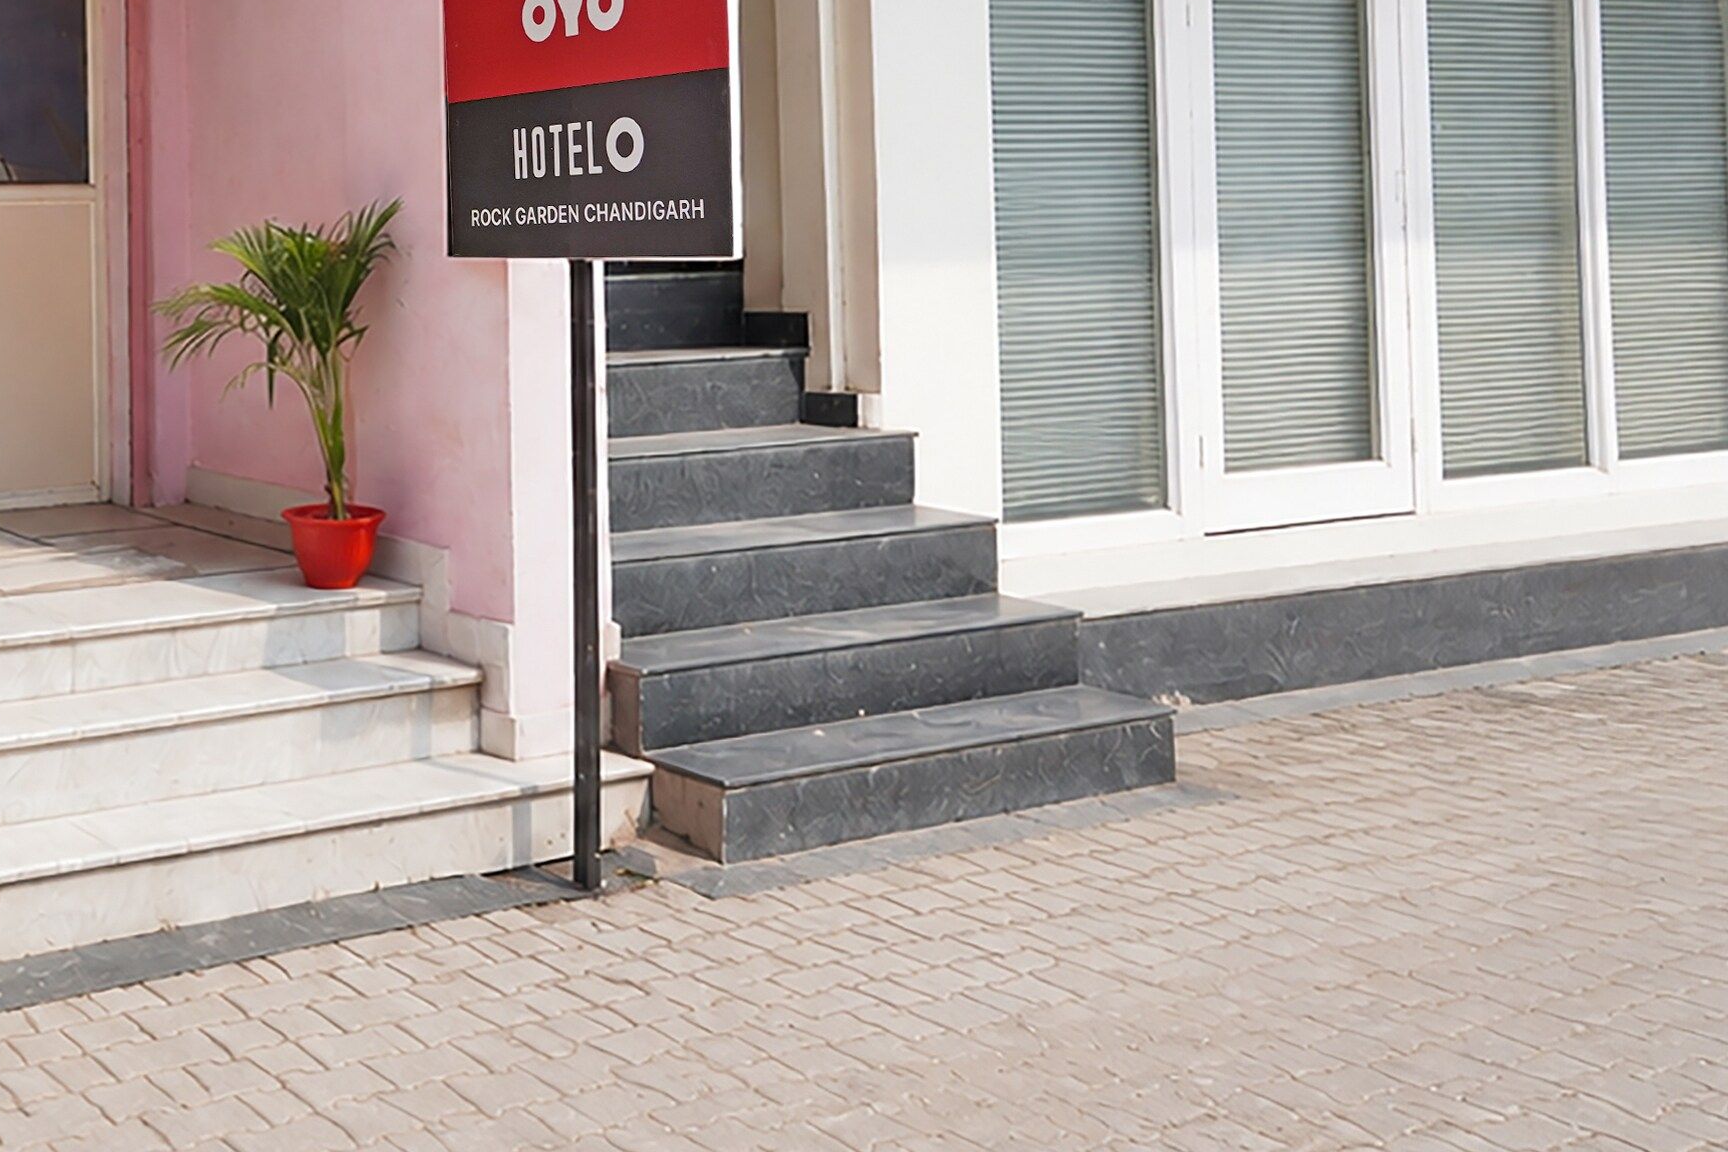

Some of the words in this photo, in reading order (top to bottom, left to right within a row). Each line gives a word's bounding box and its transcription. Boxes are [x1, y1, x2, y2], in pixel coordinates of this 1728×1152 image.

[471, 207, 512, 227] ROCK
[515, 203, 580, 226] GARDEN
[583, 198, 705, 223] CHANDIGARH
